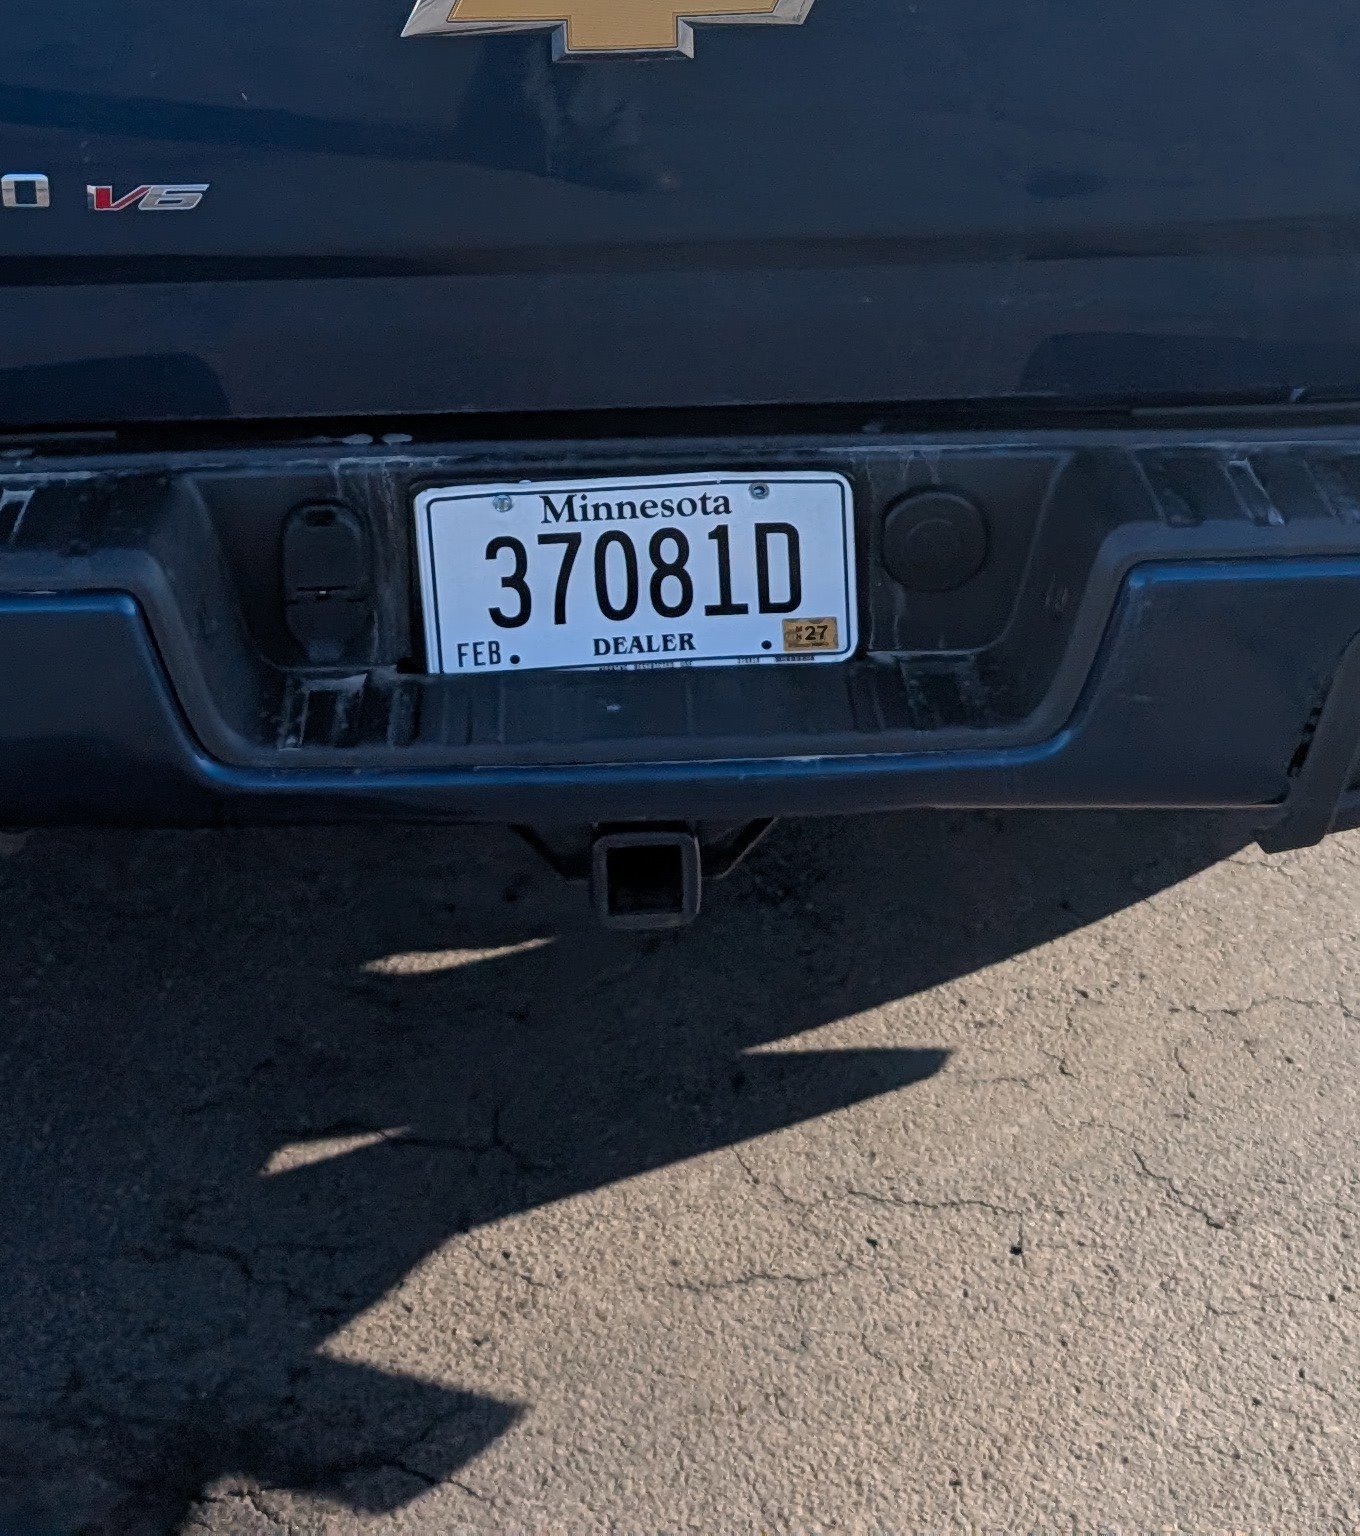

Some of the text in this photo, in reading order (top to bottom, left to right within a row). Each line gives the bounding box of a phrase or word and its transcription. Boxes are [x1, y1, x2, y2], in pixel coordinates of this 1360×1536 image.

[87, 183, 211, 212] V6
[539, 492, 732, 525] Minnesota
[484, 522, 802, 630] 37081D
[593, 632, 696, 657] DEALER
[805, 625, 829, 641] 27
